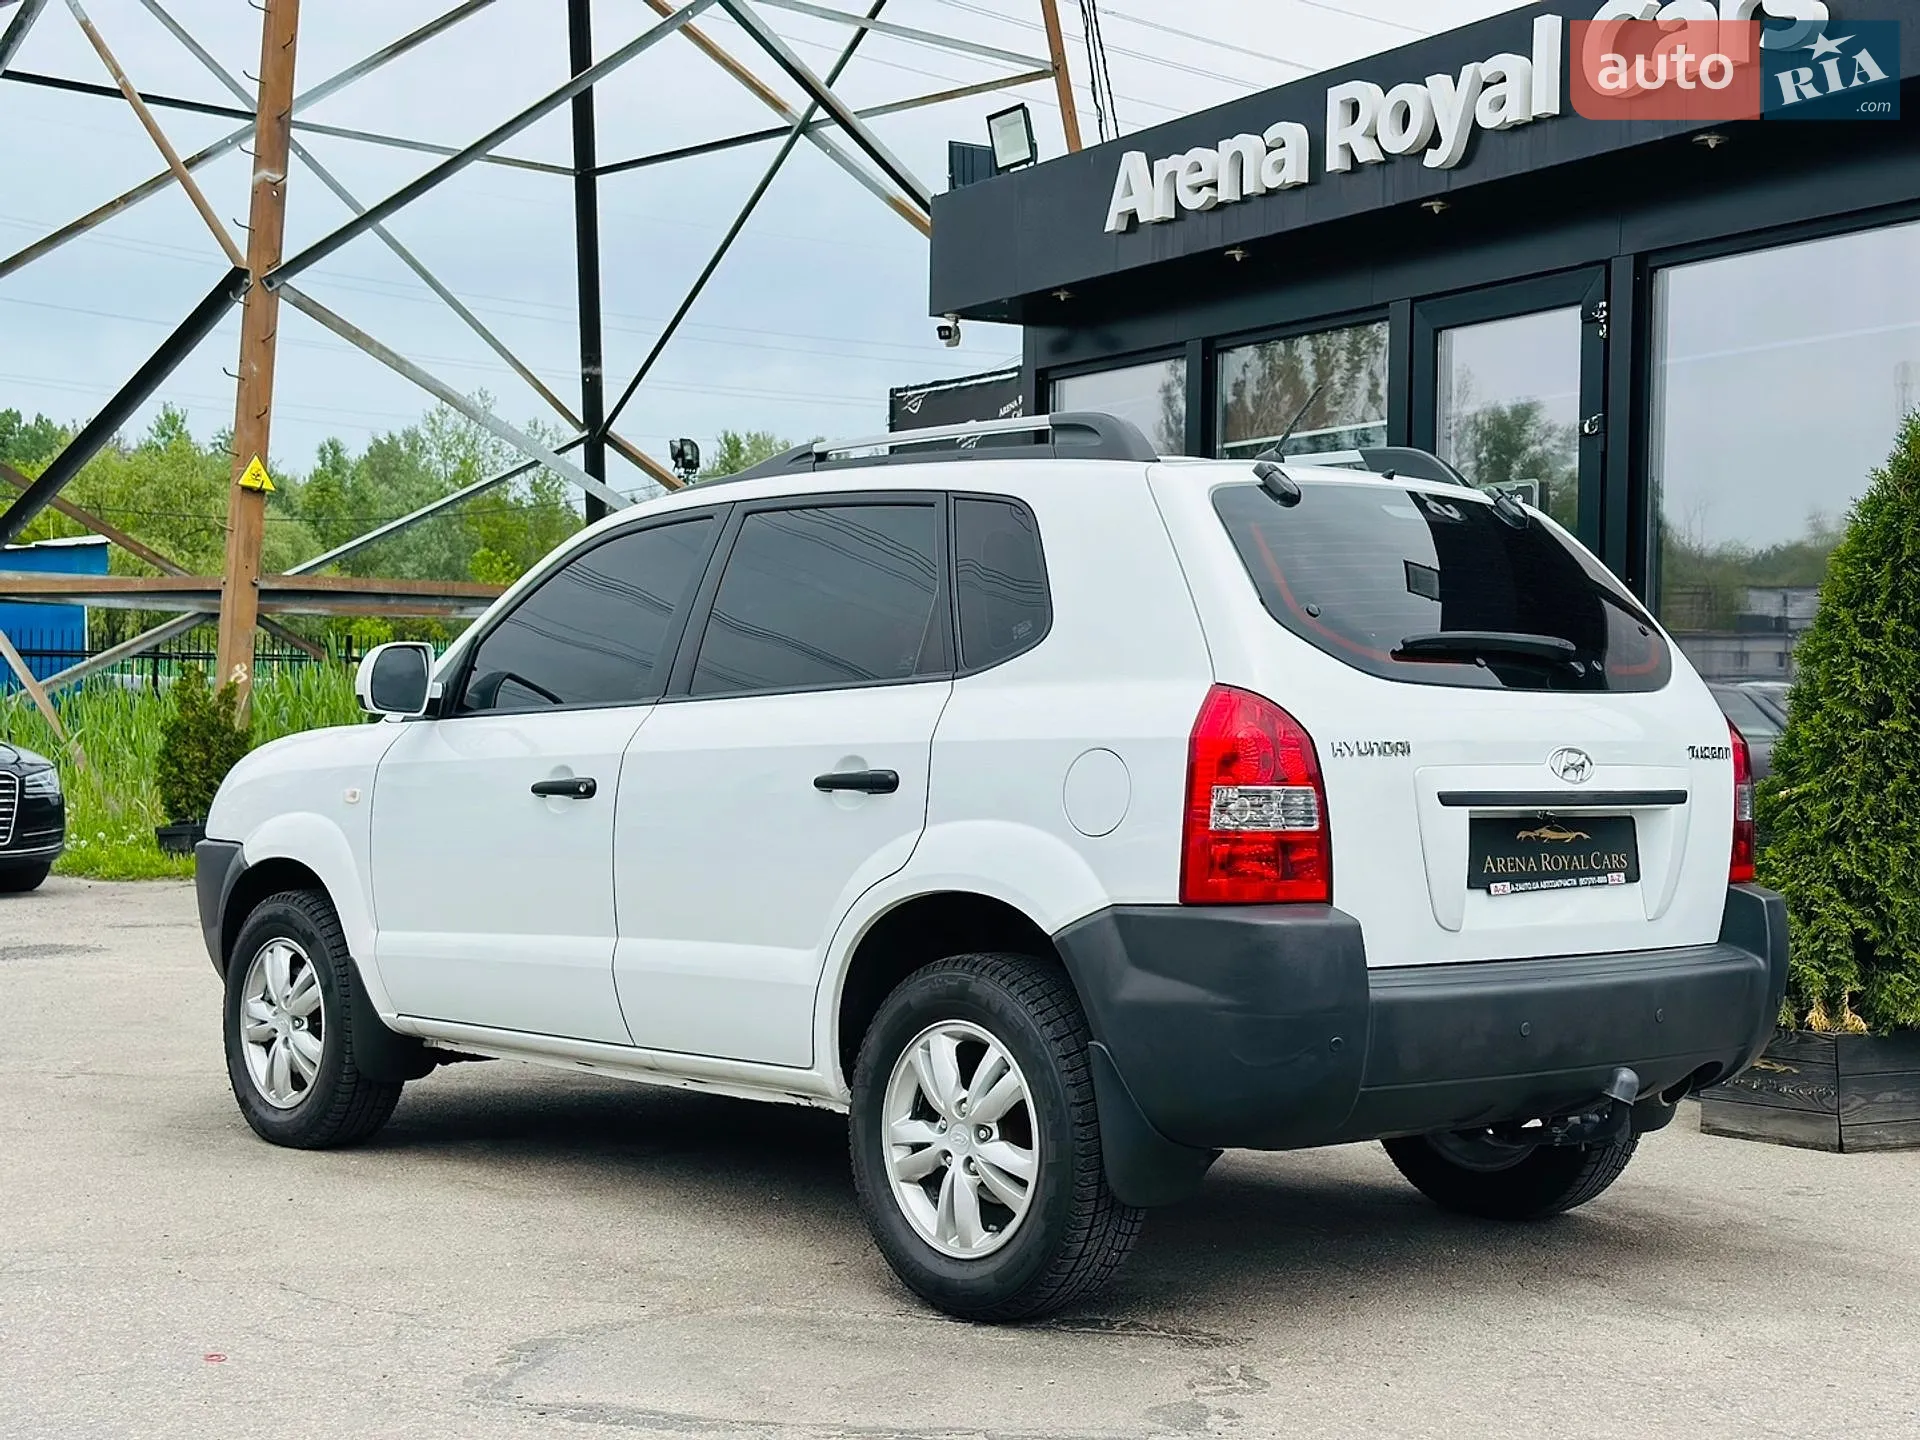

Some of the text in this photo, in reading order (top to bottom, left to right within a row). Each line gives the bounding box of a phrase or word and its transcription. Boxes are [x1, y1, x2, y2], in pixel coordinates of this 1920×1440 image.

[1105, 120, 1310, 233] Arena
[1326, 13, 1561, 169] Royal
[1330, 740, 1411, 758] HYUNDAI
[1483, 851, 1628, 874] ARENA ROYAL CARS
